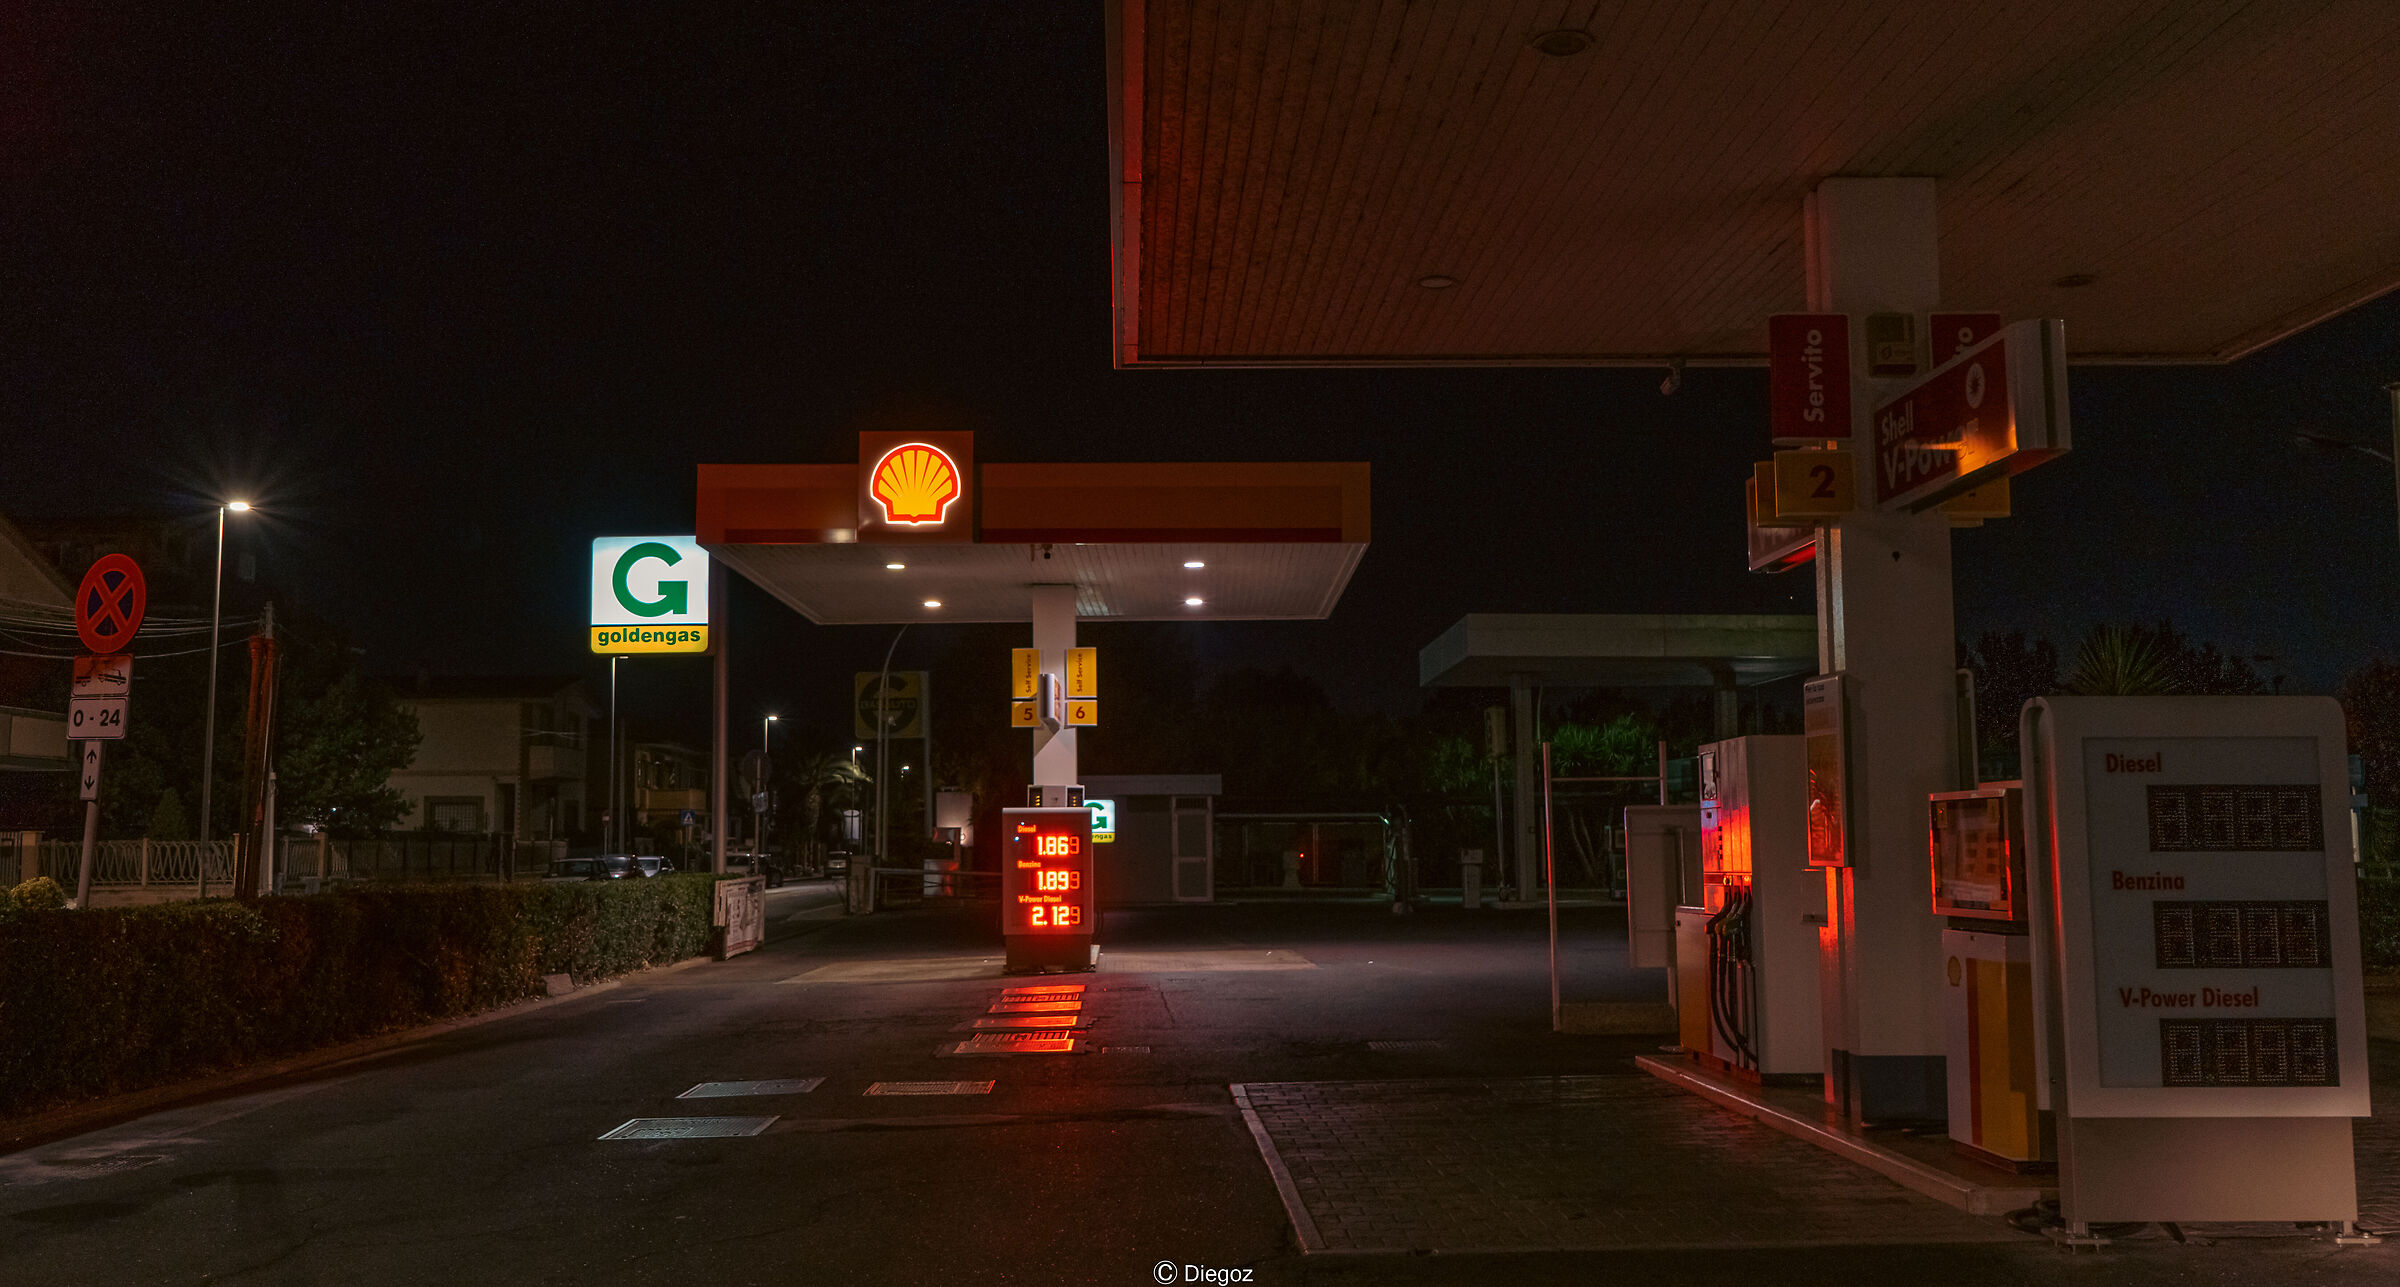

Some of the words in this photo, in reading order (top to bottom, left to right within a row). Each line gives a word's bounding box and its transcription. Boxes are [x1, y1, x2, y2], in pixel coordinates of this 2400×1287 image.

[1801, 328, 1824, 423] Servito
[1881, 399, 1914, 447] Shell
[1809, 464, 1835, 498] 2
[613, 542, 688, 617] G
[598, 628, 701, 646] goldengas
[73, 710, 84, 726] 0
[100, 709, 120, 726] 24
[1024, 707, 1033, 721] 5
[1076, 706, 1085, 719] 6
[2106, 752, 2162, 773] Diesel
[1017, 825, 1037, 833] Diesel
[1036, 836, 1080, 856] 1.869
[1036, 871, 1081, 891] 1.899
[2112, 871, 2185, 890] Benzina
[2119, 988, 2196, 1008] V-Power
[2203, 986, 2260, 1007] Diesel
